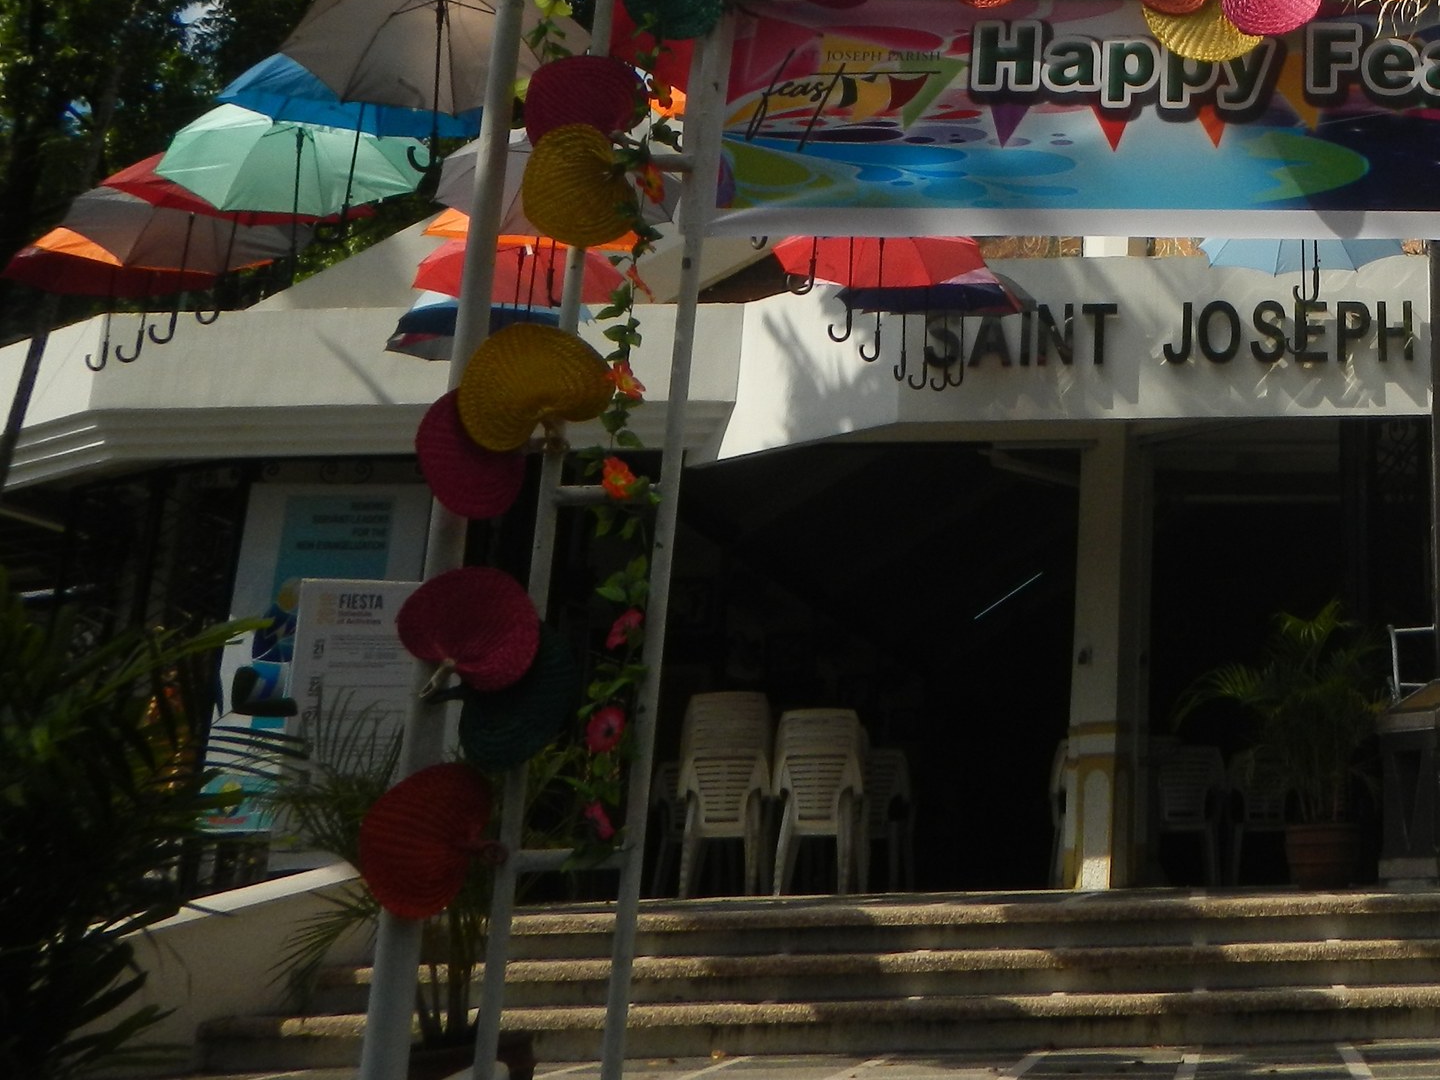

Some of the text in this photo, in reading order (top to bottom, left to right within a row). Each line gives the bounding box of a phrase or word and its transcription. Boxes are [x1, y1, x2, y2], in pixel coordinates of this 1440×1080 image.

[826, 50, 882, 62] JOSEPH
[887, 50, 941, 62] PARISH
[970, 22, 1277, 110] Happy
[924, 303, 1118, 368] SAINT
[1161, 300, 1414, 365] JOSEPH
[338, 593, 383, 610] FIESTA
